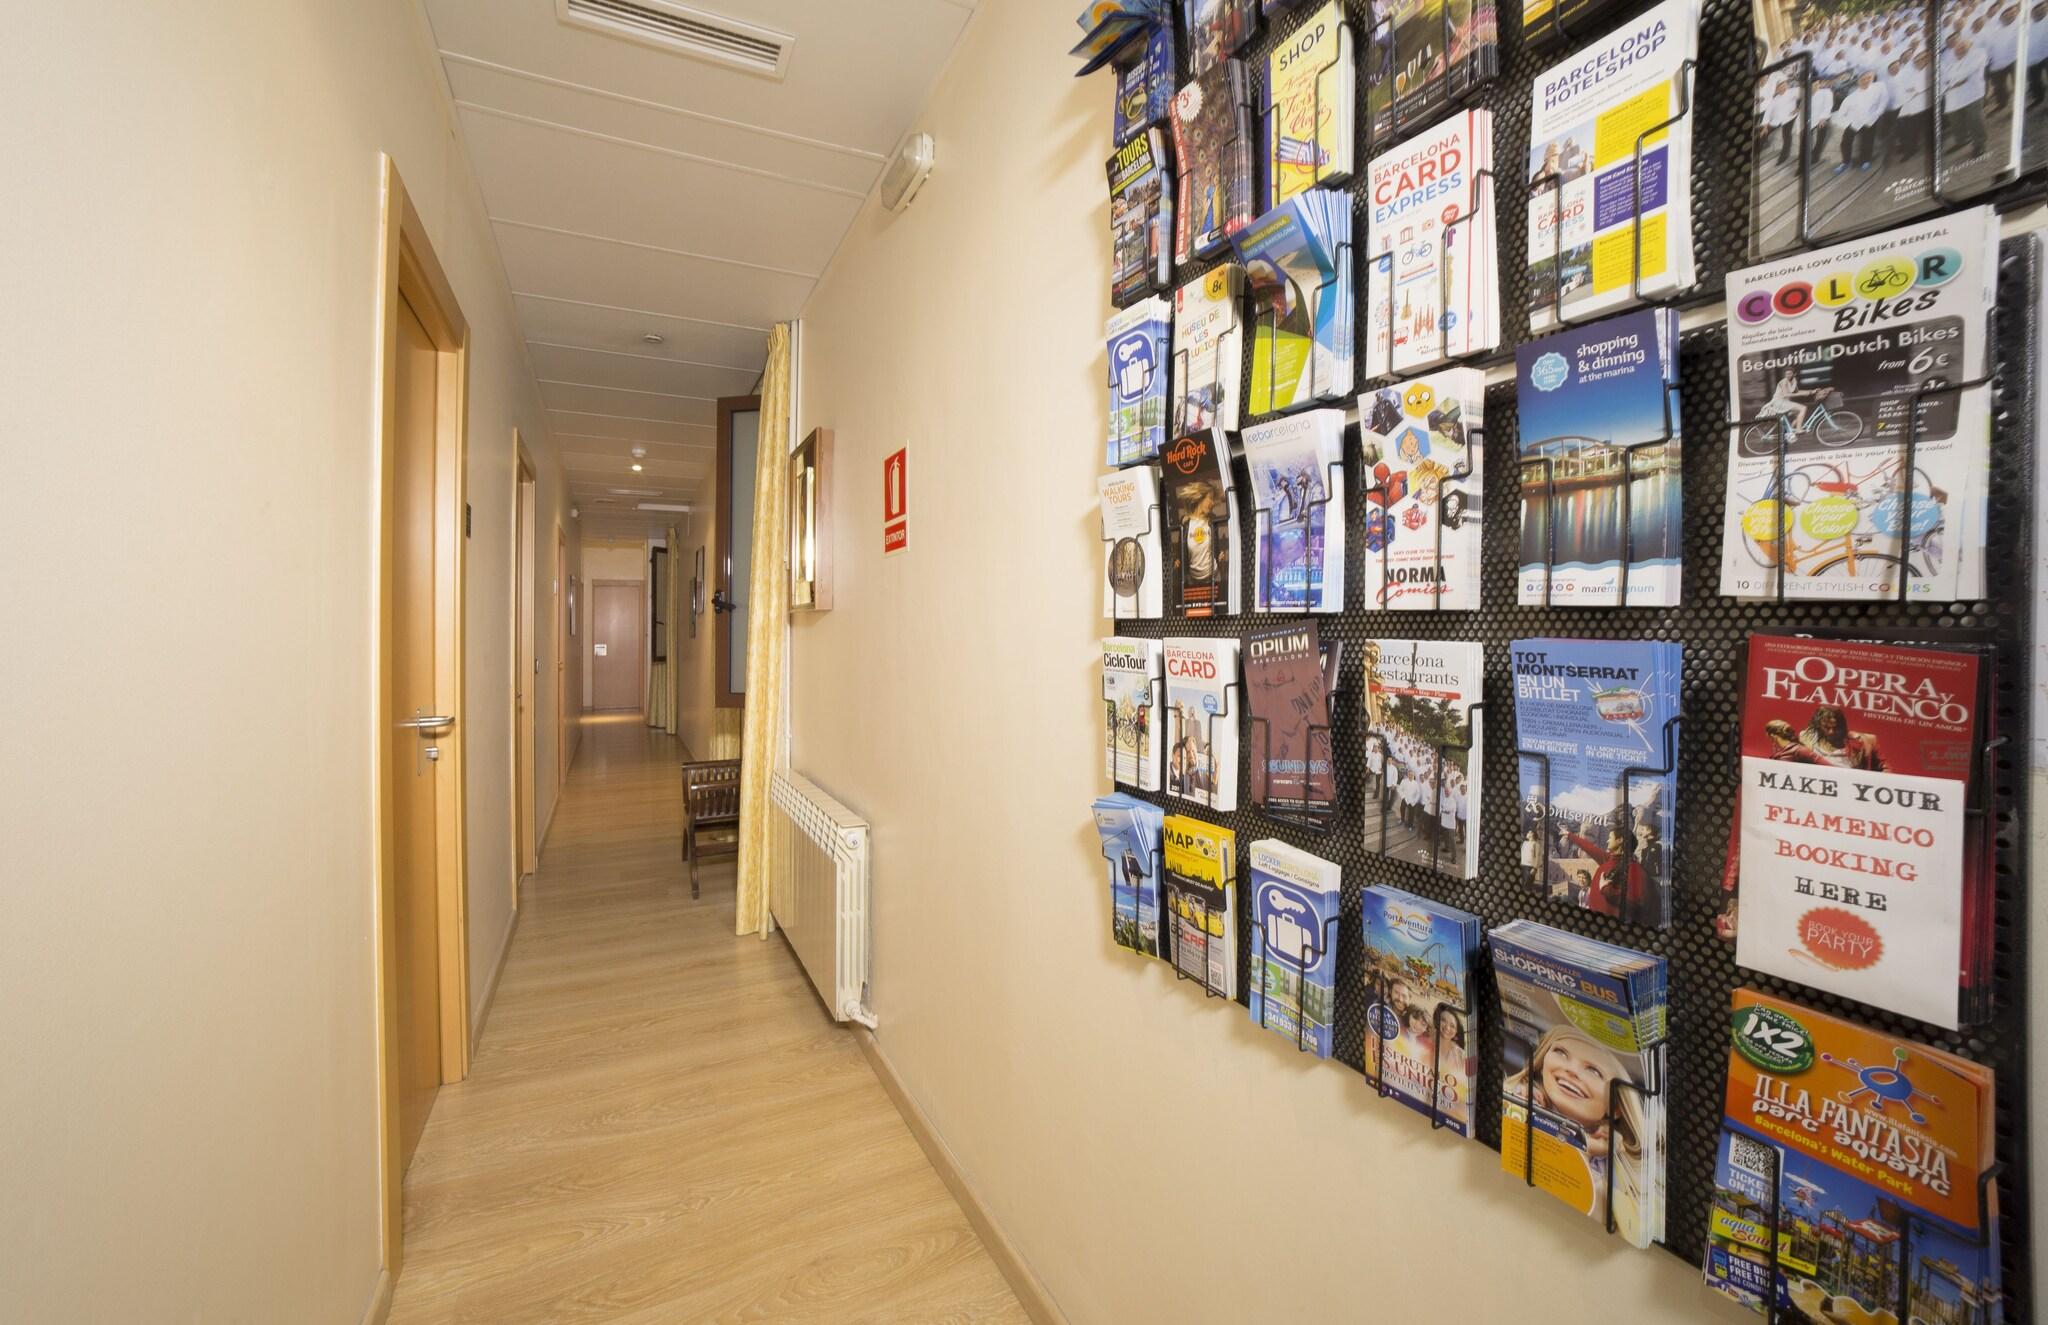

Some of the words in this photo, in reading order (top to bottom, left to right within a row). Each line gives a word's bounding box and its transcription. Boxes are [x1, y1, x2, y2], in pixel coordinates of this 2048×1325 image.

[1280, 24, 1325, 71] SHOP
[1545, 19, 1667, 97] BARCELONA
[1545, 35, 1666, 111] HOTELSHOP
[1117, 132, 1148, 170] TOURS
[1374, 134, 1460, 184] BARCELONA
[1375, 149, 1461, 205] CARD
[1376, 172, 1461, 223] EXPRESS
[1537, 203, 1584, 231] CARD
[1745, 264, 1804, 285] BARCELONA
[1806, 256, 1832, 269] LOW
[1835, 249, 1865, 262] COST
[1869, 242, 1896, 254] BIKE
[1900, 228, 1949, 247] RENTAL
[1209, 309, 1221, 323] DE
[1833, 289, 1940, 332] Bikes
[1195, 328, 1209, 344] LES
[1576, 333, 1639, 359] shopping
[1578, 361, 1590, 373] &
[1592, 349, 1645, 370] dinning
[1742, 346, 1822, 373] Beautiful
[1830, 338, 1890, 359] Dutch
[1899, 327, 1959, 347] Bikes
[1579, 376, 1588, 384] at
[1588, 373, 1602, 382] the
[1603, 366, 1635, 378] marina
[1878, 359, 1905, 372] from
[1167, 449, 1187, 465] Hard
[1186, 441, 1207, 461] Rock
[1103, 482, 1135, 497] WALKING
[1108, 493, 1132, 505] TOURS
[1384, 565, 1447, 583] NORMA
[1737, 581, 1750, 590] 10
[1754, 581, 1812, 592] DIFFRENT
[1816, 582, 1863, 592] STYLISH
[1376, 581, 1454, 605] Comics
[1272, 628, 1296, 637] SUNDAY
[1166, 649, 1214, 660] BARCELONA
[1250, 633, 1309, 658] OPIUM
[1515, 652, 1548, 664] TOT
[1168, 658, 1216, 679] CARD
[1253, 652, 1309, 665] BARCELONA
[1370, 667, 1460, 687] Restaurants
[1516, 663, 1639, 681] MONTSERRAT
[1517, 675, 1540, 688] EN
[1542, 677, 1565, 689] UN
[1794, 656, 1939, 700] OPERA
[1518, 687, 1581, 702] BITLLET
[1761, 667, 1969, 724] FLAMENCO
[1904, 718, 1918, 726] DE
[1920, 720, 1934, 728] UN
[1585, 749, 1595, 757] IN
[1597, 750, 1614, 759] ONE
[1616, 752, 1648, 763] TICKET
[1758, 771, 1838, 798] MAKE
[1853, 783, 1943, 812] YOUR
[1165, 828, 1194, 849] MAP
[1765, 804, 1934, 848] FLAMENCO
[1775, 838, 1918, 882] BOOKING
[1794, 876, 1887, 912] HERE
[1384, 910, 1433, 935] PortAventura
[1808, 920, 1838, 935] BOOK
[1841, 931, 1874, 946] YOUR
[1807, 926, 1873, 959] PARTY
[1494, 947, 1577, 988] SHOPPING
[1580, 979, 1619, 1004] BUS
[1752, 1073, 1812, 1119] ILLA
[1818, 1096, 1950, 1183] FANTASIA
[1752, 1100, 1820, 1133] parc
[1834, 1131, 1950, 1197] aquatic
[1754, 1114, 1829, 1154] Barcelona's
[1831, 1144, 1875, 1175] Water
[1877, 1168, 1913, 1196] Park
[1720, 1217, 1756, 1233] aqua
[1729, 1255, 1752, 1270] FREE
[1730, 1264, 1753, 1283] FREE
[1754, 1274, 1785, 1295] TRAN
